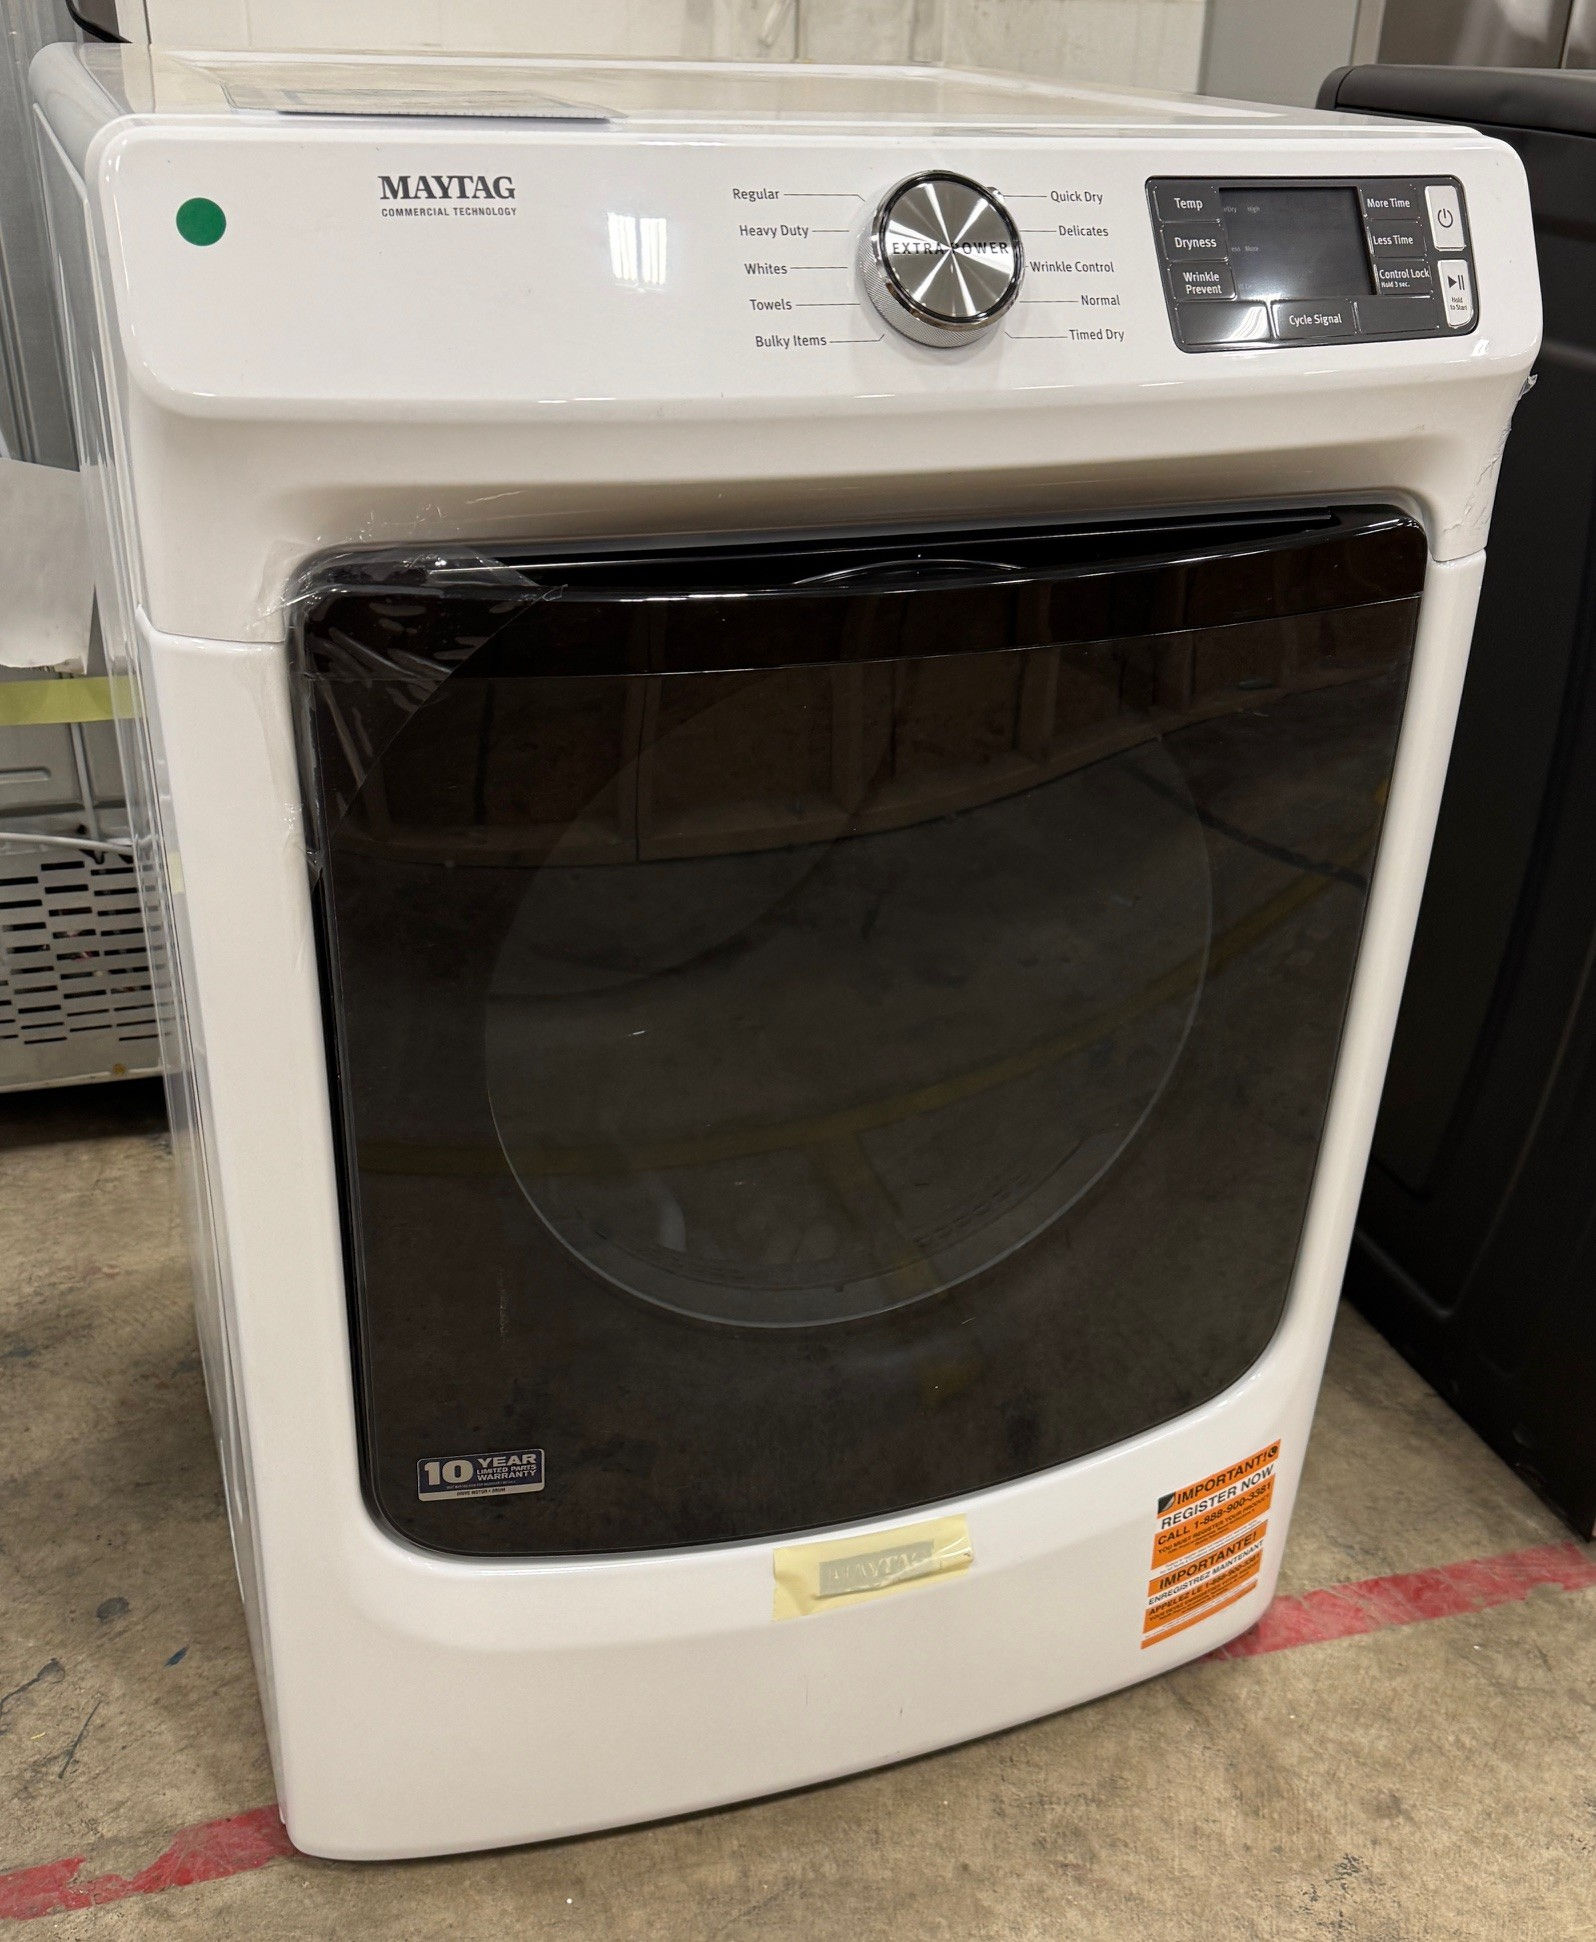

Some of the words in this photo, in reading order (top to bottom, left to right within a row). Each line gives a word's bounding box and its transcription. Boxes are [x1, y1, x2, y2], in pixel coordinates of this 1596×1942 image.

[378, 175, 516, 200] MAYTAG
[732, 188, 780, 202] Regular
[1050, 190, 1082, 203] Quick
[1084, 191, 1104, 205] Dry
[1173, 197, 1203, 211] Temp
[1366, 198, 1389, 208] More
[1389, 198, 1411, 208] Time
[381, 207, 450, 217] COMMERCIAL
[453, 207, 517, 216] TECHNOLOGY
[739, 224, 777, 239] Heavy
[780, 224, 809, 239] Duty
[1058, 225, 1109, 237] Delicates
[1174, 237, 1217, 251] Dryness
[1372, 235, 1392, 245] Less
[1392, 234, 1414, 245] Time
[892, 242, 945, 255] EXTRA
[950, 241, 1009, 255] POWER
[744, 262, 788, 275] Whites
[1030, 260, 1072, 273] Wrinkle
[1075, 261, 1114, 273] Control
[1379, 268, 1410, 279] Control
[1410, 268, 1430, 278] Lock
[1182, 271, 1220, 282] Wrinkle
[1185, 284, 1222, 294] Prevent
[749, 298, 793, 311] Towels
[1081, 294, 1121, 306] Normal
[1289, 314, 1313, 328] Cycle
[1313, 313, 1342, 326] Signal
[755, 335, 790, 349] Bulky
[793, 335, 827, 347] Items
[1069, 328, 1103, 341] Timed
[1105, 328, 1125, 342] Dry
[424, 1459, 474, 1486] 10
[477, 1453, 537, 1468] YEAR
[476, 1466, 509, 1475] LIMITED
[510, 1464, 537, 1472] PARTS
[476, 1470, 537, 1481] WARRANTY
[1176, 1450, 1267, 1505] IMPORTANT!
[1161, 1485, 1237, 1530] REGISTER
[1240, 1463, 1274, 1492] NOW
[1158, 1526, 1190, 1546] CALL
[1158, 1531, 1257, 1590] IMPORTANTE!
[1148, 1570, 1212, 1606] ENREGISTREZ
[1211, 1539, 1264, 1574] MAINTENANT
